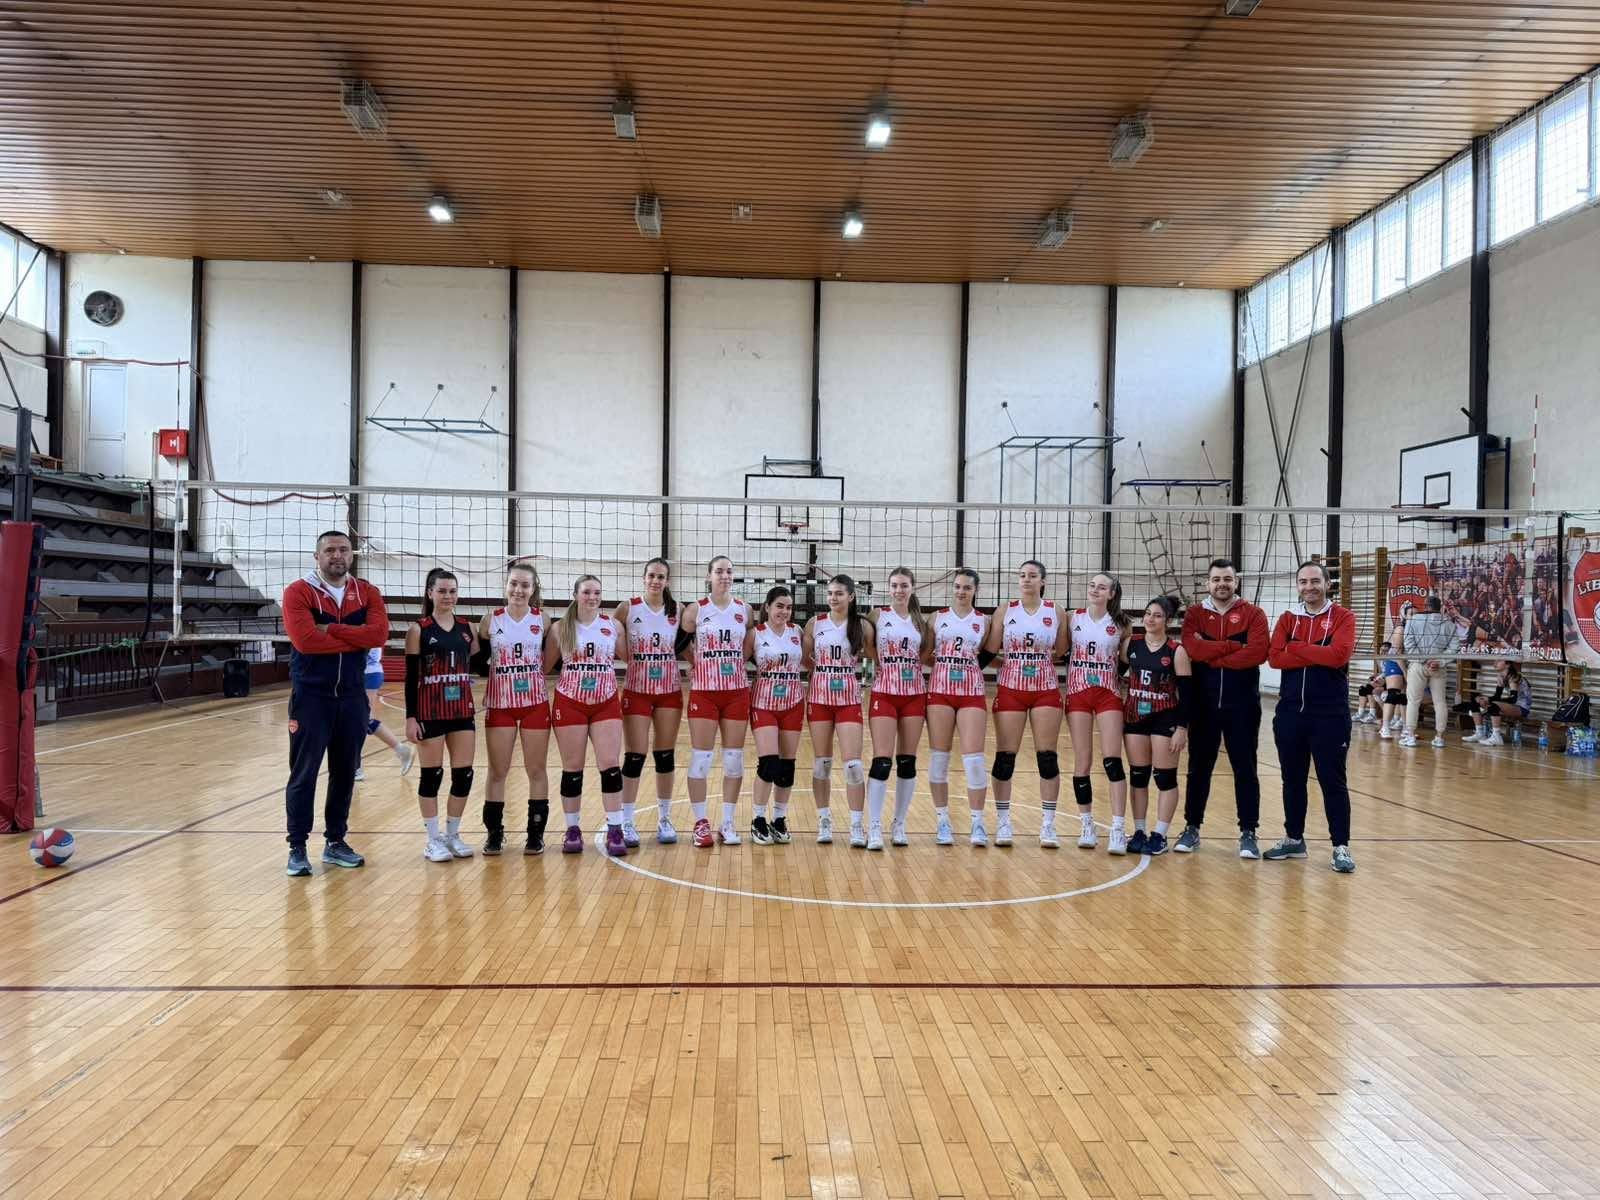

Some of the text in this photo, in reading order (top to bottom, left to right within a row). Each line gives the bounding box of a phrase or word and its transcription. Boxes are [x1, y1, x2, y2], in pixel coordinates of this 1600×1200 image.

[1390, 584, 1427, 598] LIBERO
[653, 632, 661, 648] 3
[719, 629, 731, 644] 14
[901, 637, 909, 651] 4
[955, 636, 964, 652] 2
[1026, 632, 1035, 648] 5
[514, 642, 523, 659] 9
[586, 642, 595, 658] 8
[830, 645, 842, 661] 10
[1088, 641, 1097, 656] 6
[780, 653, 789, 667] 11
[1140, 669, 1153, 686] 15
